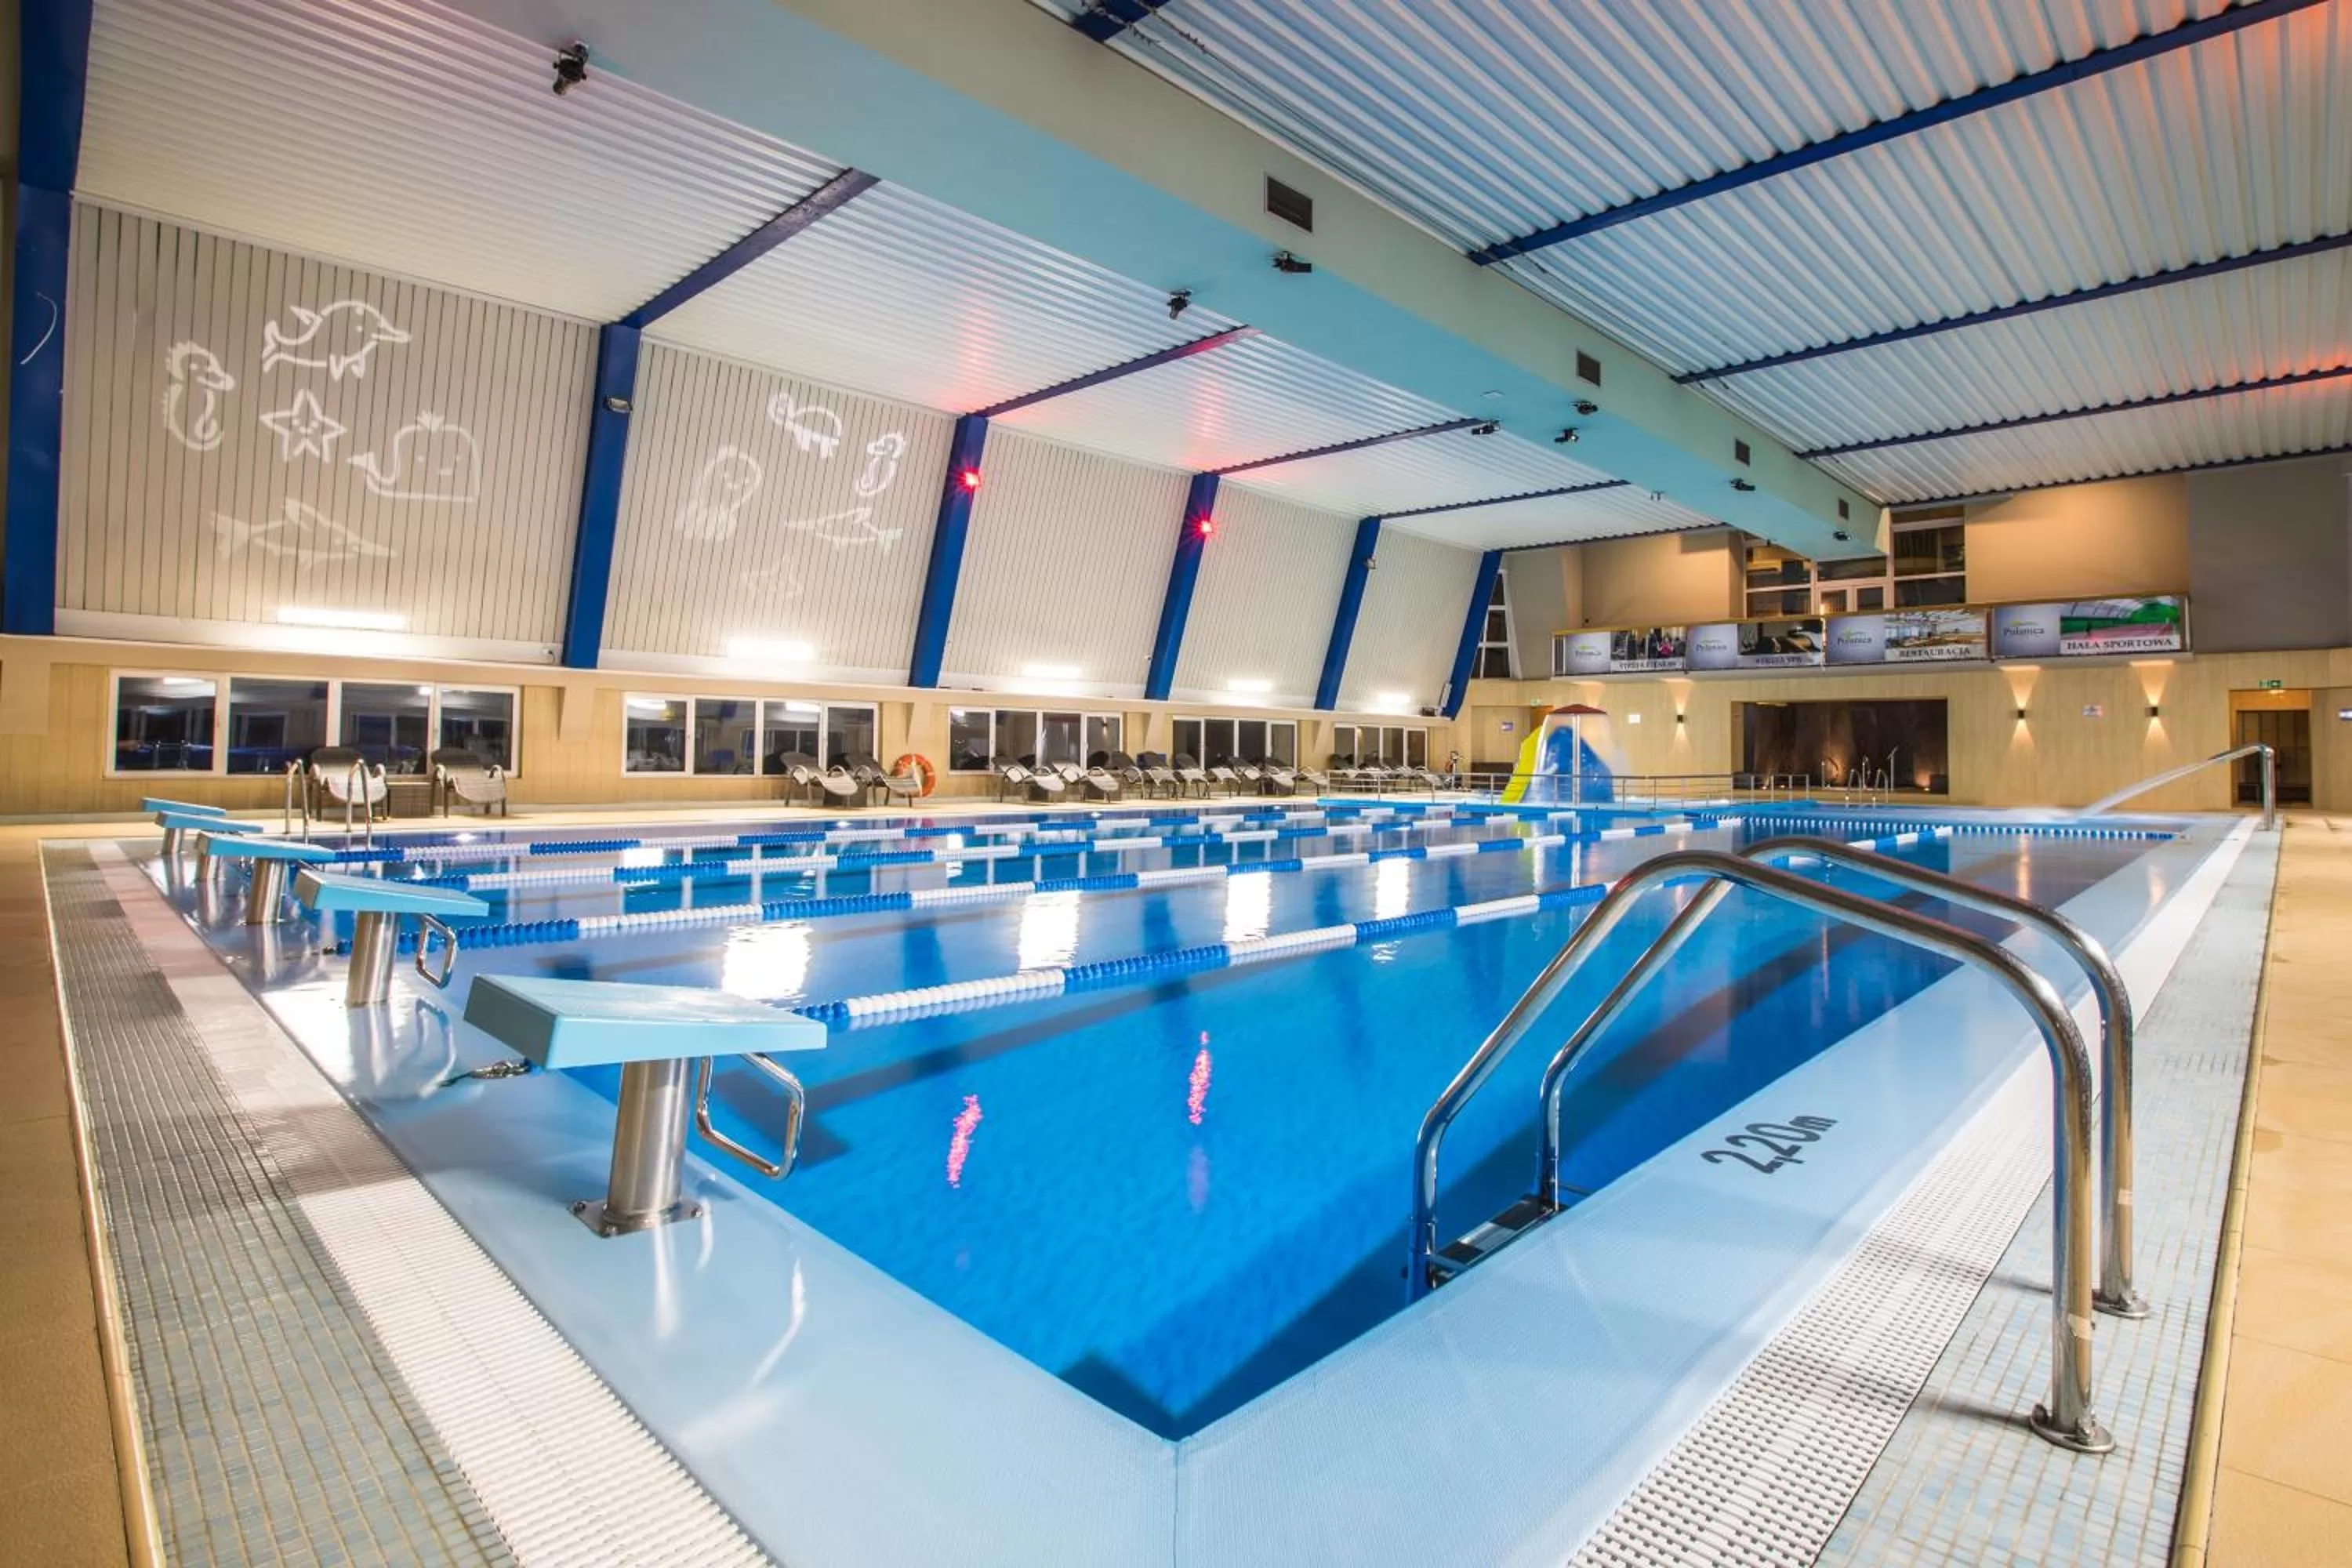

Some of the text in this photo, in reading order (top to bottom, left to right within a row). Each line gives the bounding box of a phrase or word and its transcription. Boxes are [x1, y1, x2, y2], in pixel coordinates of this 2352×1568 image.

[2067, 637, 2172, 650] HALA SPORTOWA
[1700, 1116, 1838, 1174] 2,20m
